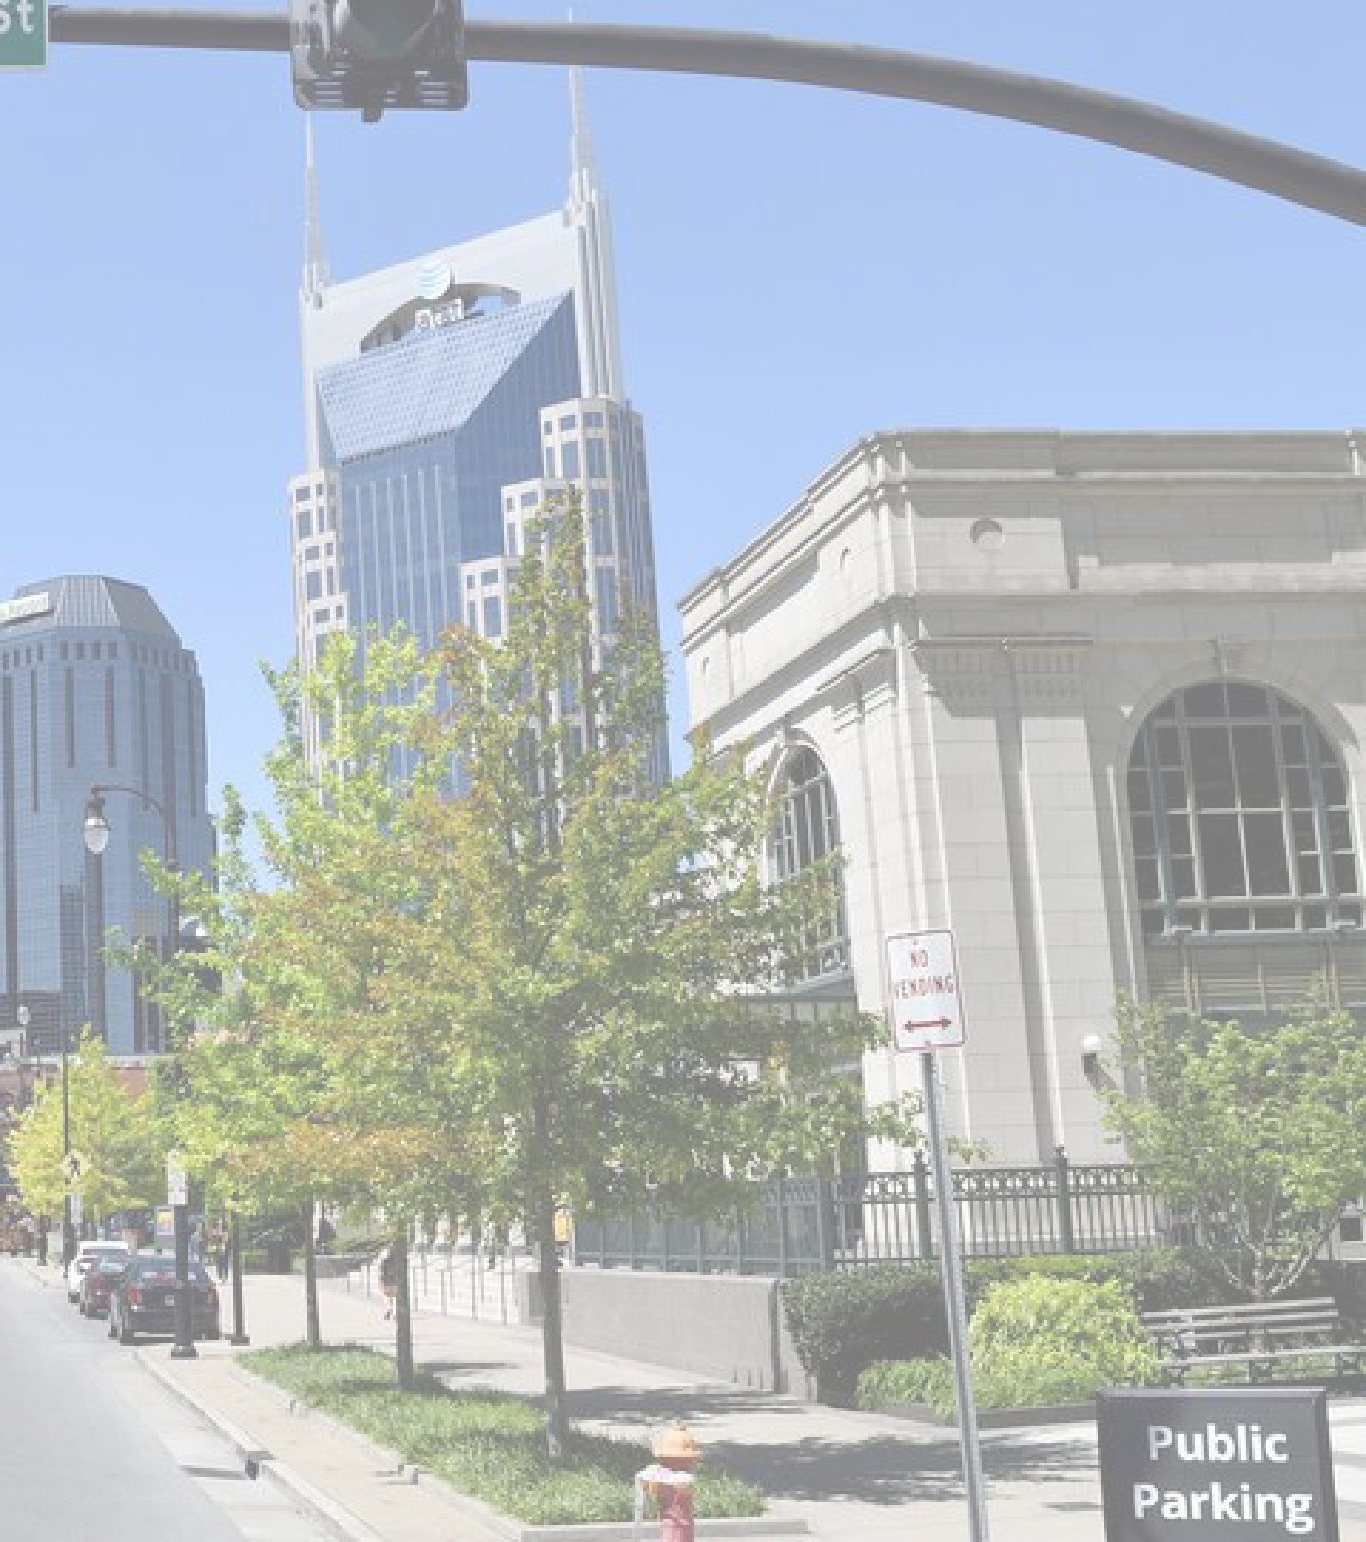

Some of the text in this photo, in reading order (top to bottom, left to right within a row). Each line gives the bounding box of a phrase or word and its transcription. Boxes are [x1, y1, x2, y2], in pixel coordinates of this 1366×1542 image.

[910, 949, 929, 968] NO
[891, 974, 955, 999] VENDING
[1147, 1423, 1289, 1463] Public
[1134, 1482, 1316, 1534] Parking
